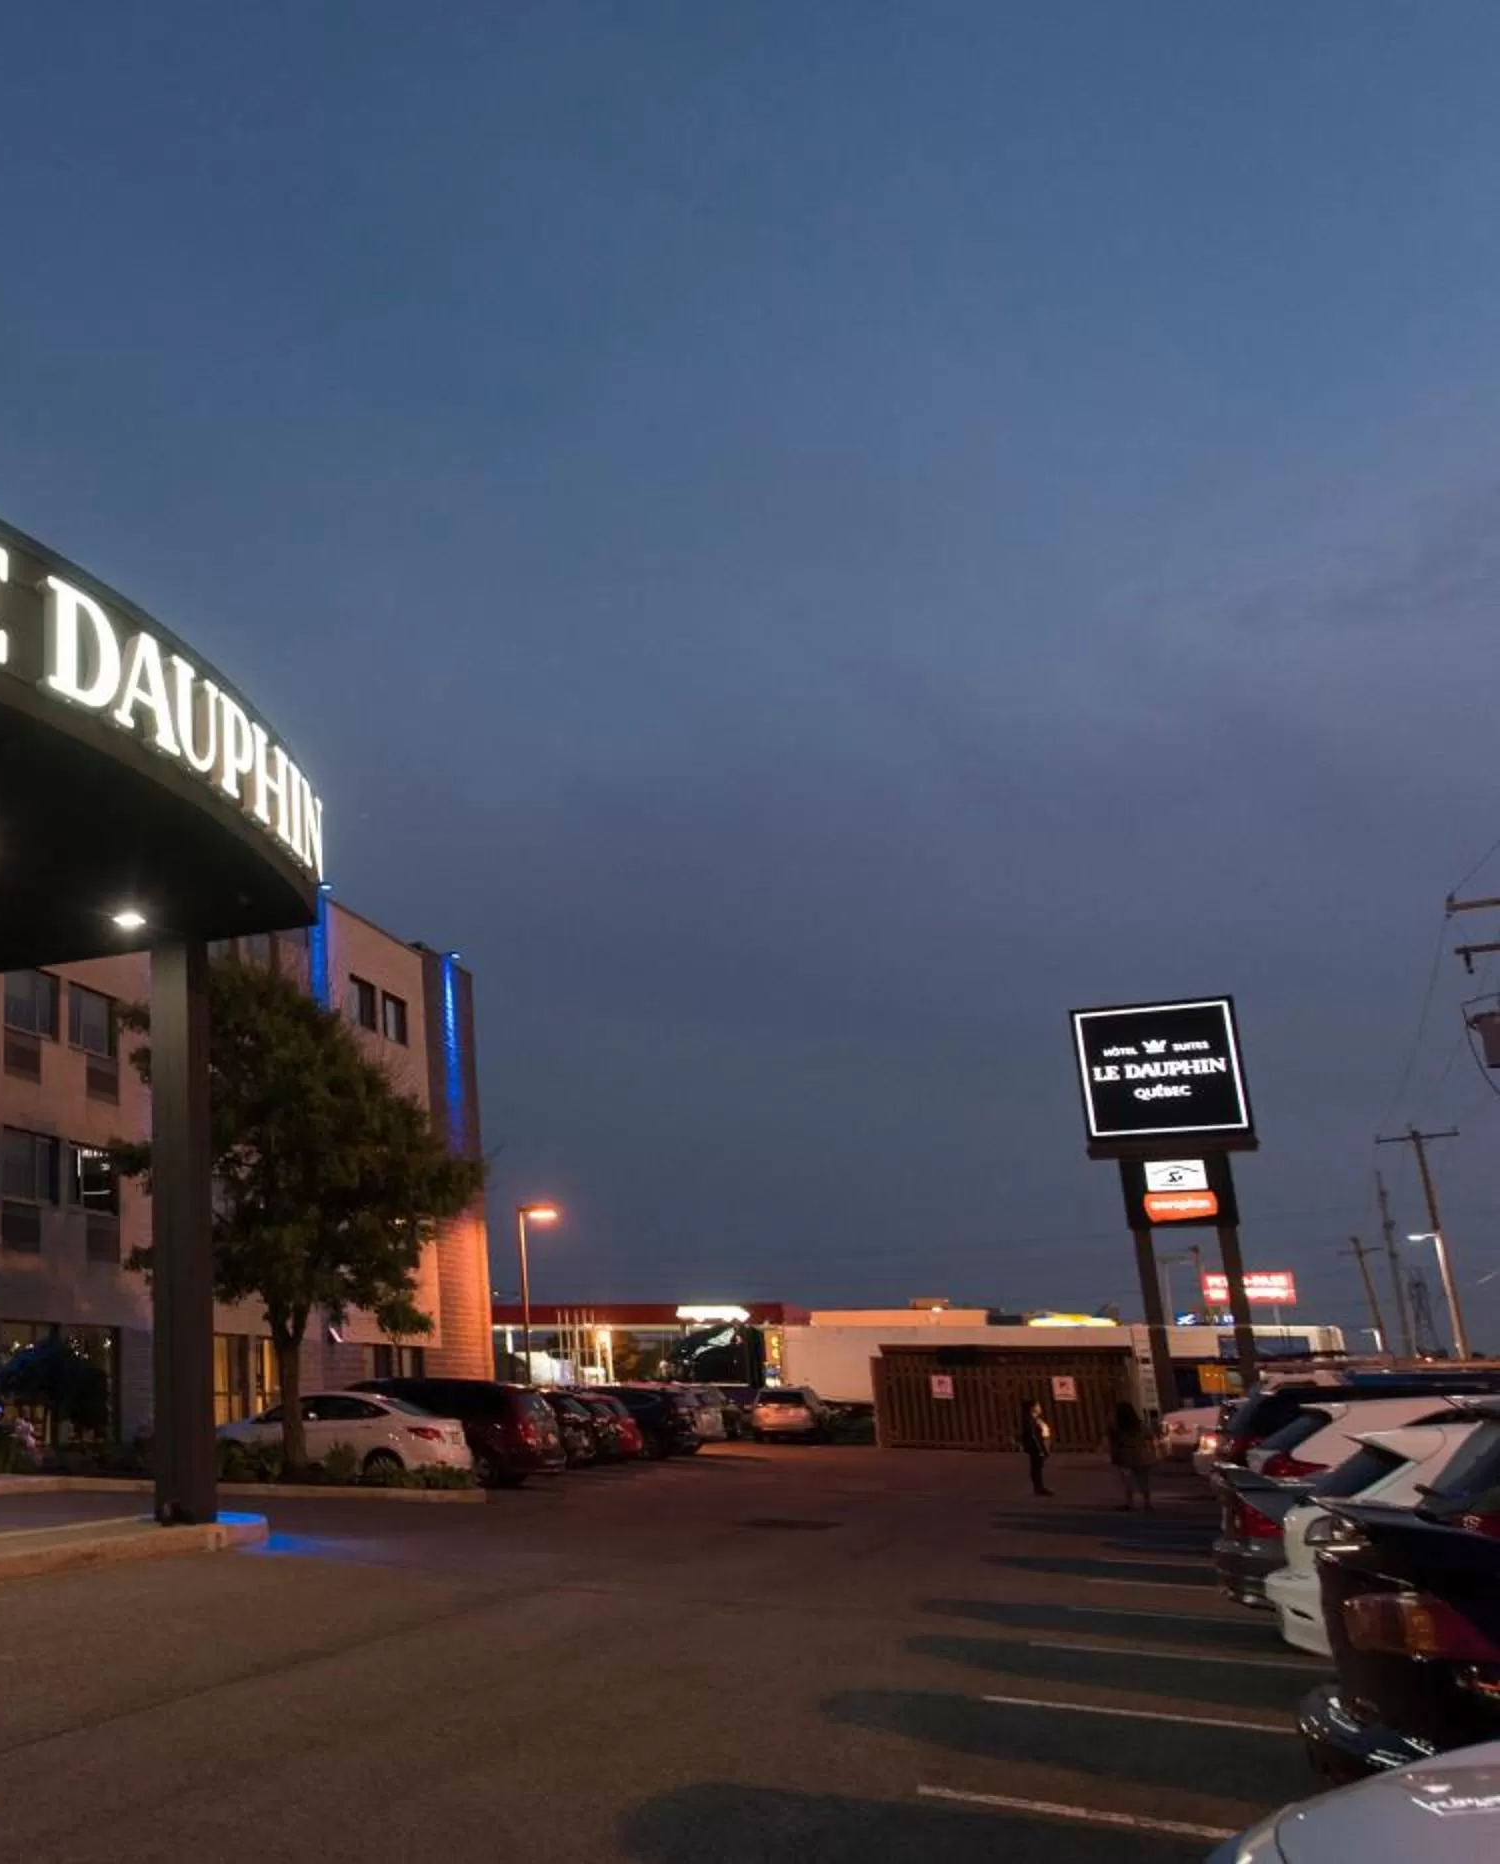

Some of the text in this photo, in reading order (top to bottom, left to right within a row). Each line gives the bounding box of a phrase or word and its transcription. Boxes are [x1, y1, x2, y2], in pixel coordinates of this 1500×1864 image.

[44, 574, 324, 885] DAUPHIN
[1092, 1057, 1227, 1082] LE DAUPHIN
[1133, 1083, 1193, 1101] QUÉBEC
